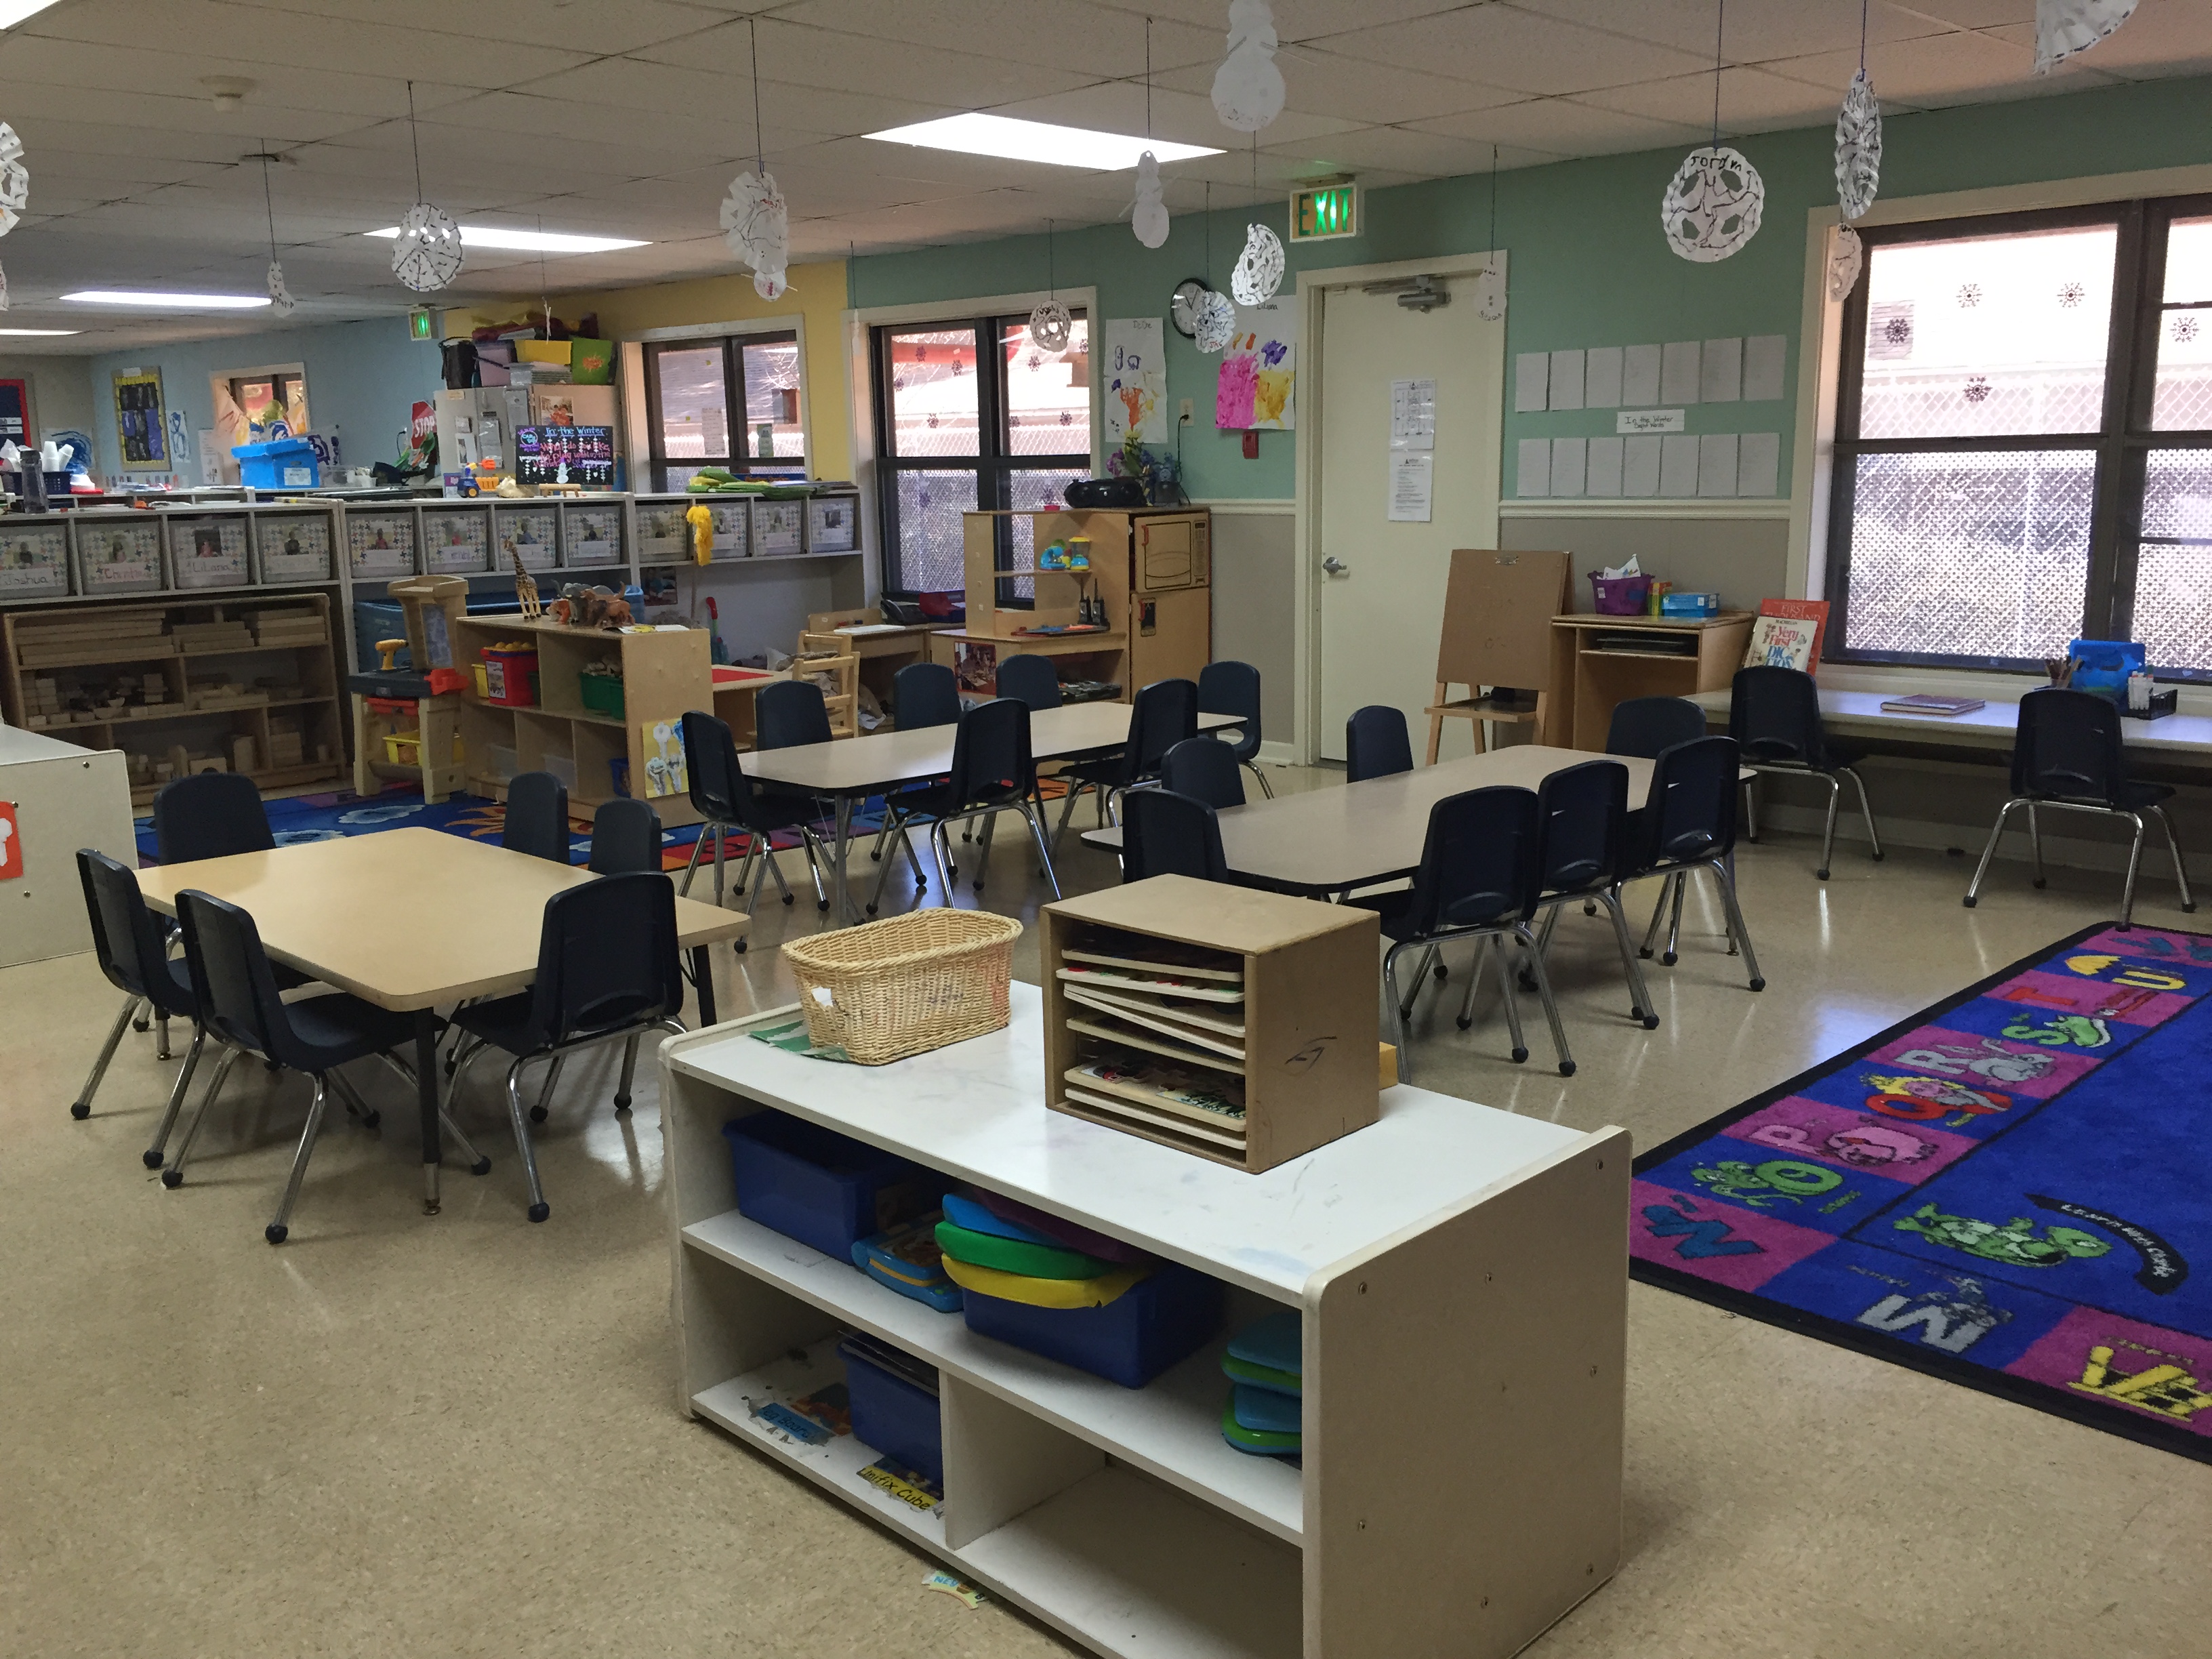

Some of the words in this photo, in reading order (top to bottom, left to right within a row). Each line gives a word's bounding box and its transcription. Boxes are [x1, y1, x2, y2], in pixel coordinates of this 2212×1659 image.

[1298, 188, 1352, 236] EXIT
[414, 415, 435, 438] STOP
[558, 426, 575, 435] the
[576, 426, 606, 435] Winter
[1781, 605, 1807, 615] FIRST
[1769, 634, 1790, 647] First
[1778, 626, 1799, 641] Very
[2001, 1025, 2070, 1045] S
[1894, 1050, 1971, 1075] R
